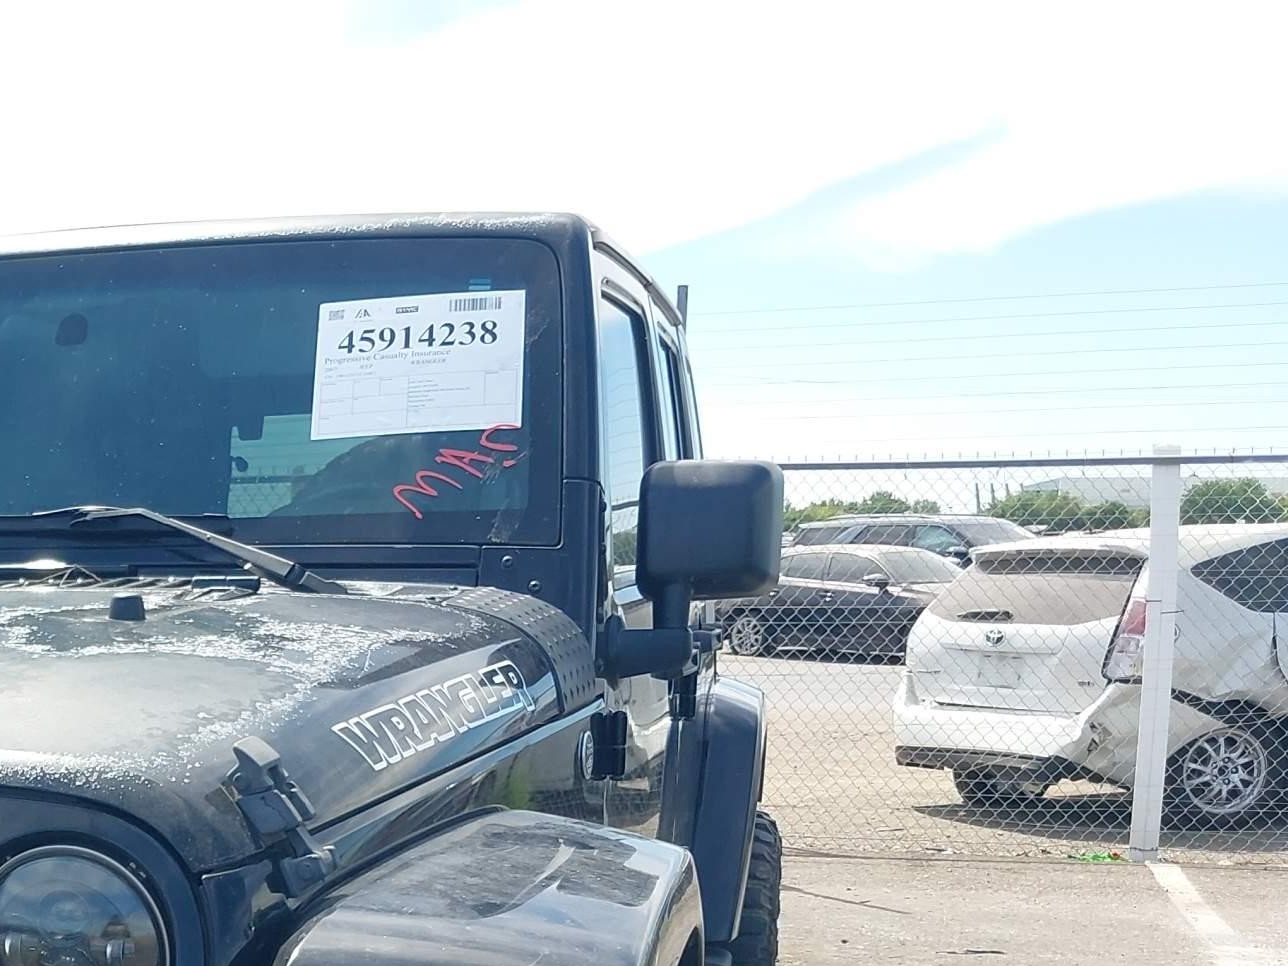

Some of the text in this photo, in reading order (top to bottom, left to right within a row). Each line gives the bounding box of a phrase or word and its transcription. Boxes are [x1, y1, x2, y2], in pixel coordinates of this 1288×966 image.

[338, 320, 498, 354] 45914238
[373, 351, 408, 360] Casualty
[411, 349, 451, 358] Insurance
[331, 660, 535, 771] WRANGLER
